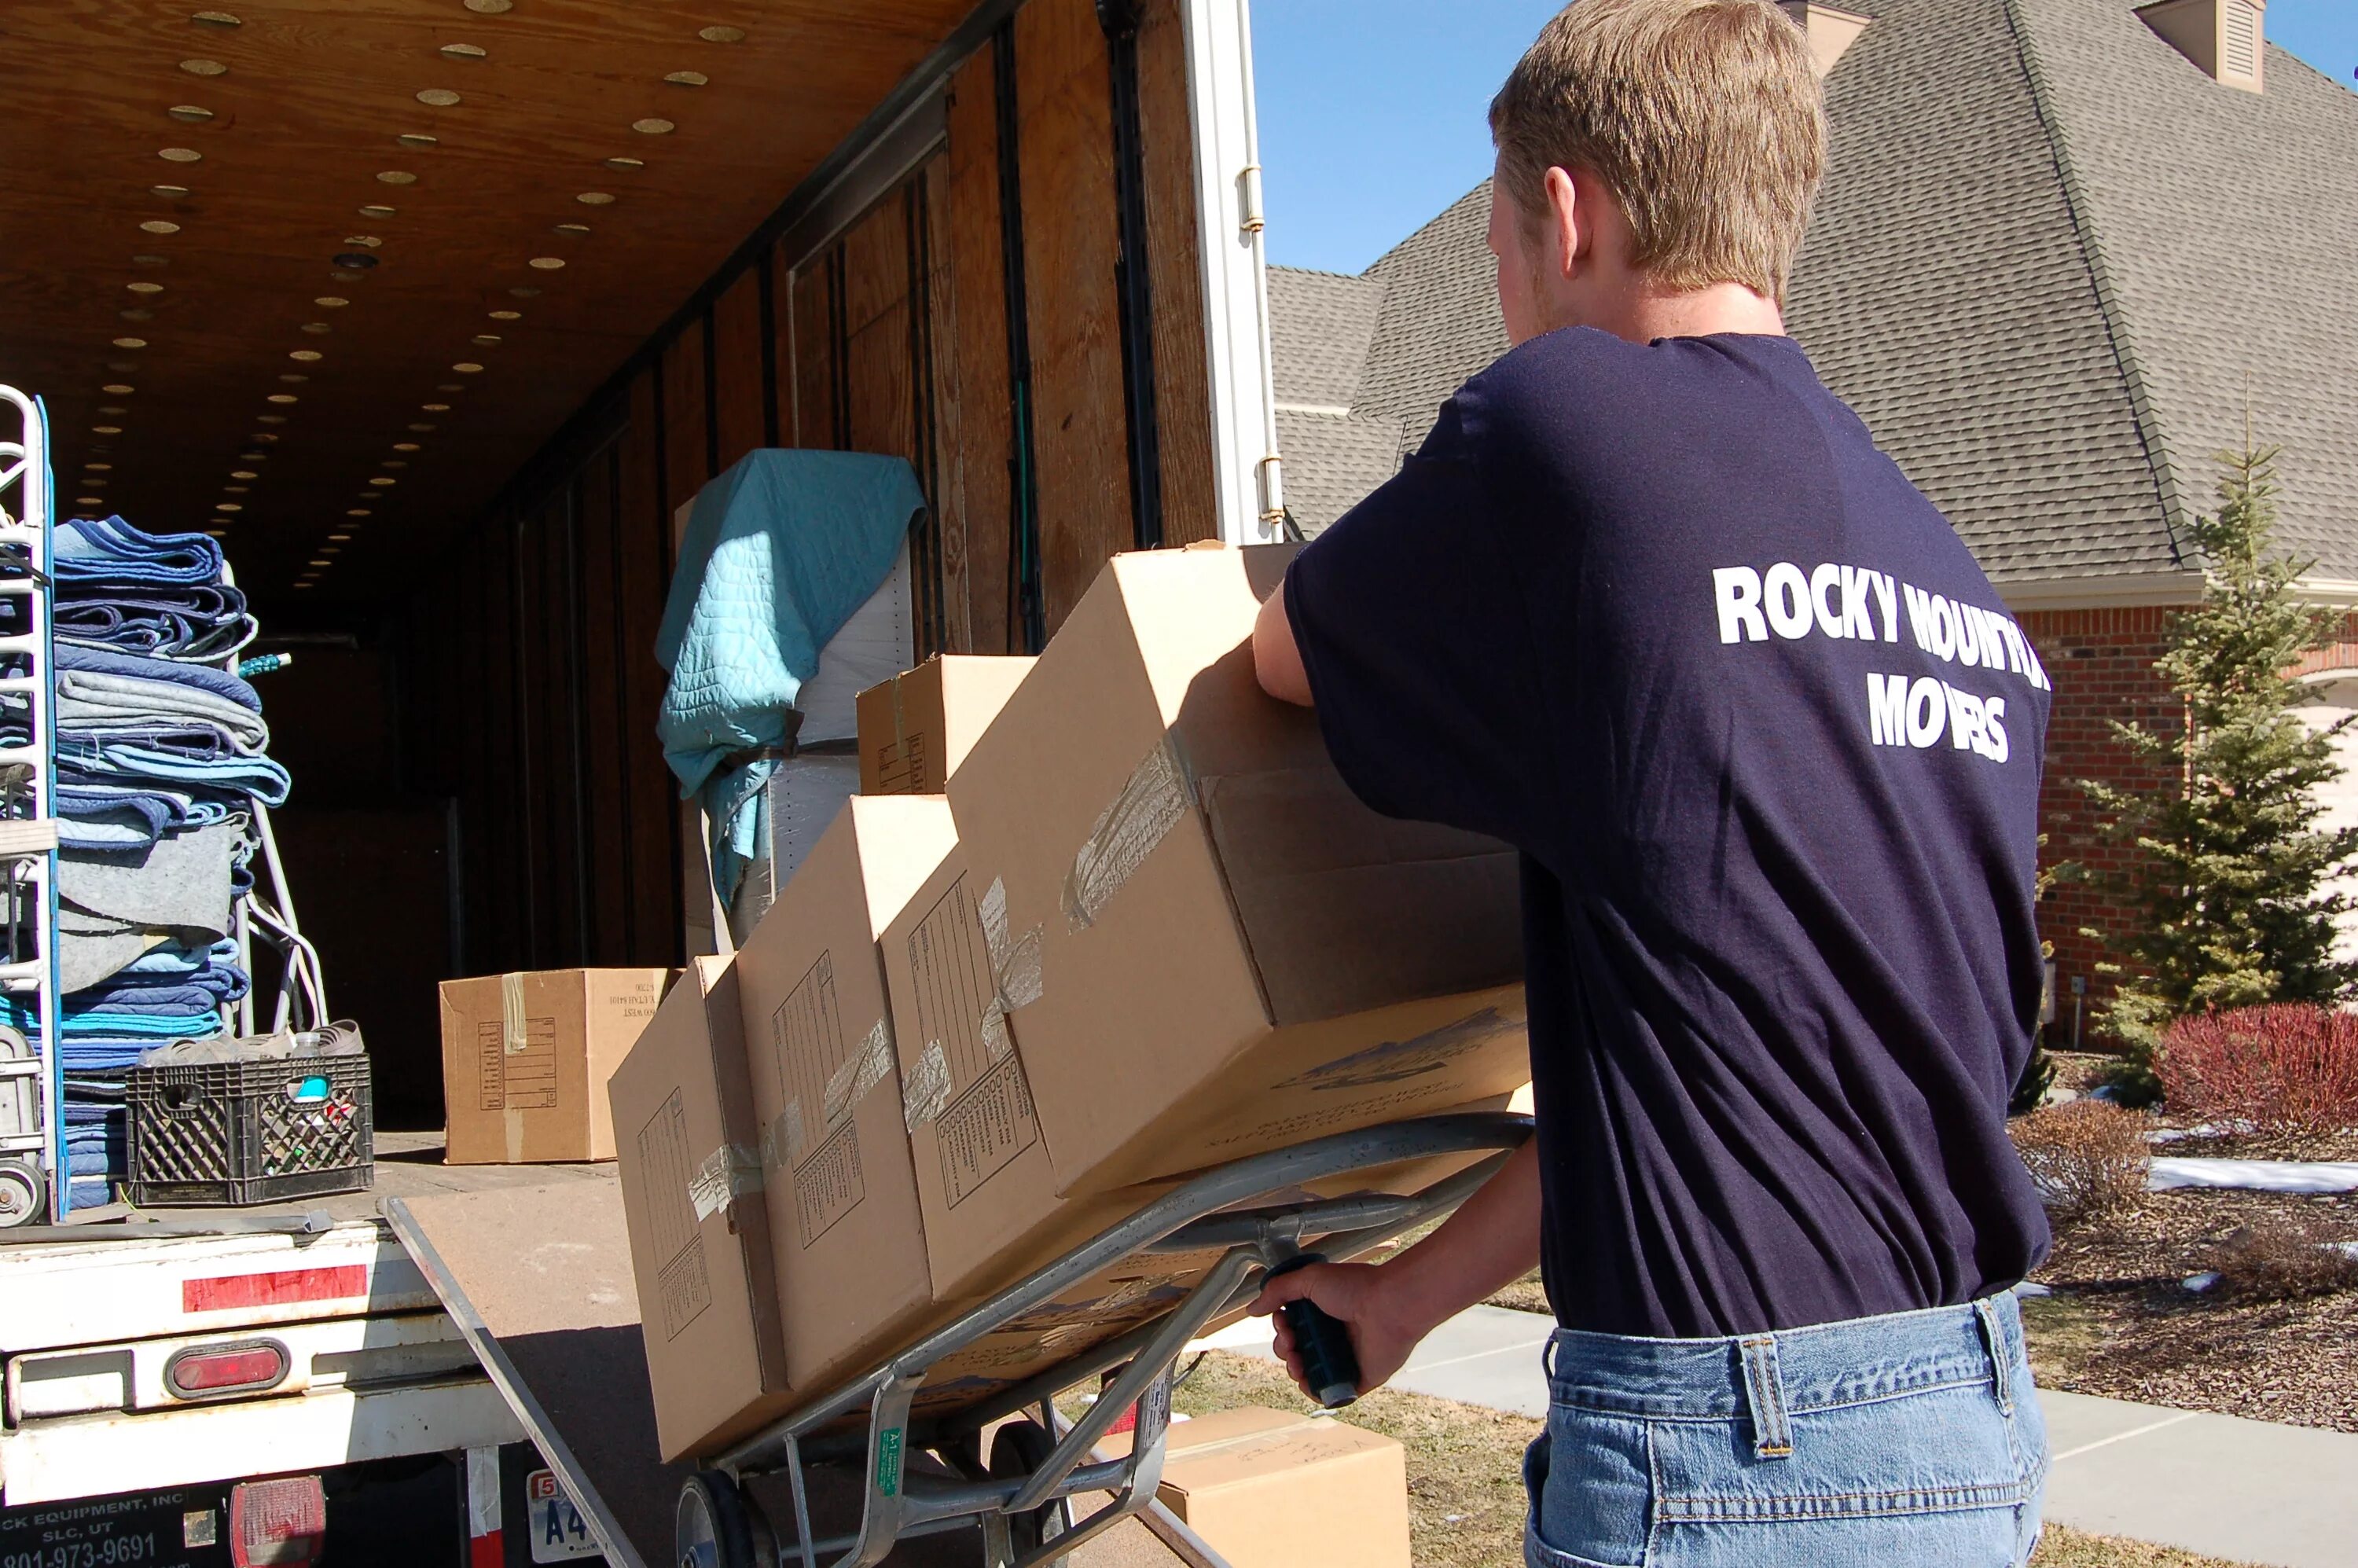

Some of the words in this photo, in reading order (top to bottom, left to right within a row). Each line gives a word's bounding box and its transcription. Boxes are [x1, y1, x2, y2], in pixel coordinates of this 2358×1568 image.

[1713, 562, 1898, 644] ROCKY
[623, 1008, 643, 1017] WEST
[1013, 1075, 1024, 1119] MASTER
[889, 1431, 900, 1449] A-1
[542, 1479, 555, 1495] 5
[34, 1498, 148, 1525] EQUIPMENT,
[152, 1493, 184, 1507] INC
[42, 1527, 83, 1544] SLC,
[89, 1522, 114, 1535] UT
[3, 1533, 156, 1568] 801-973-9691
